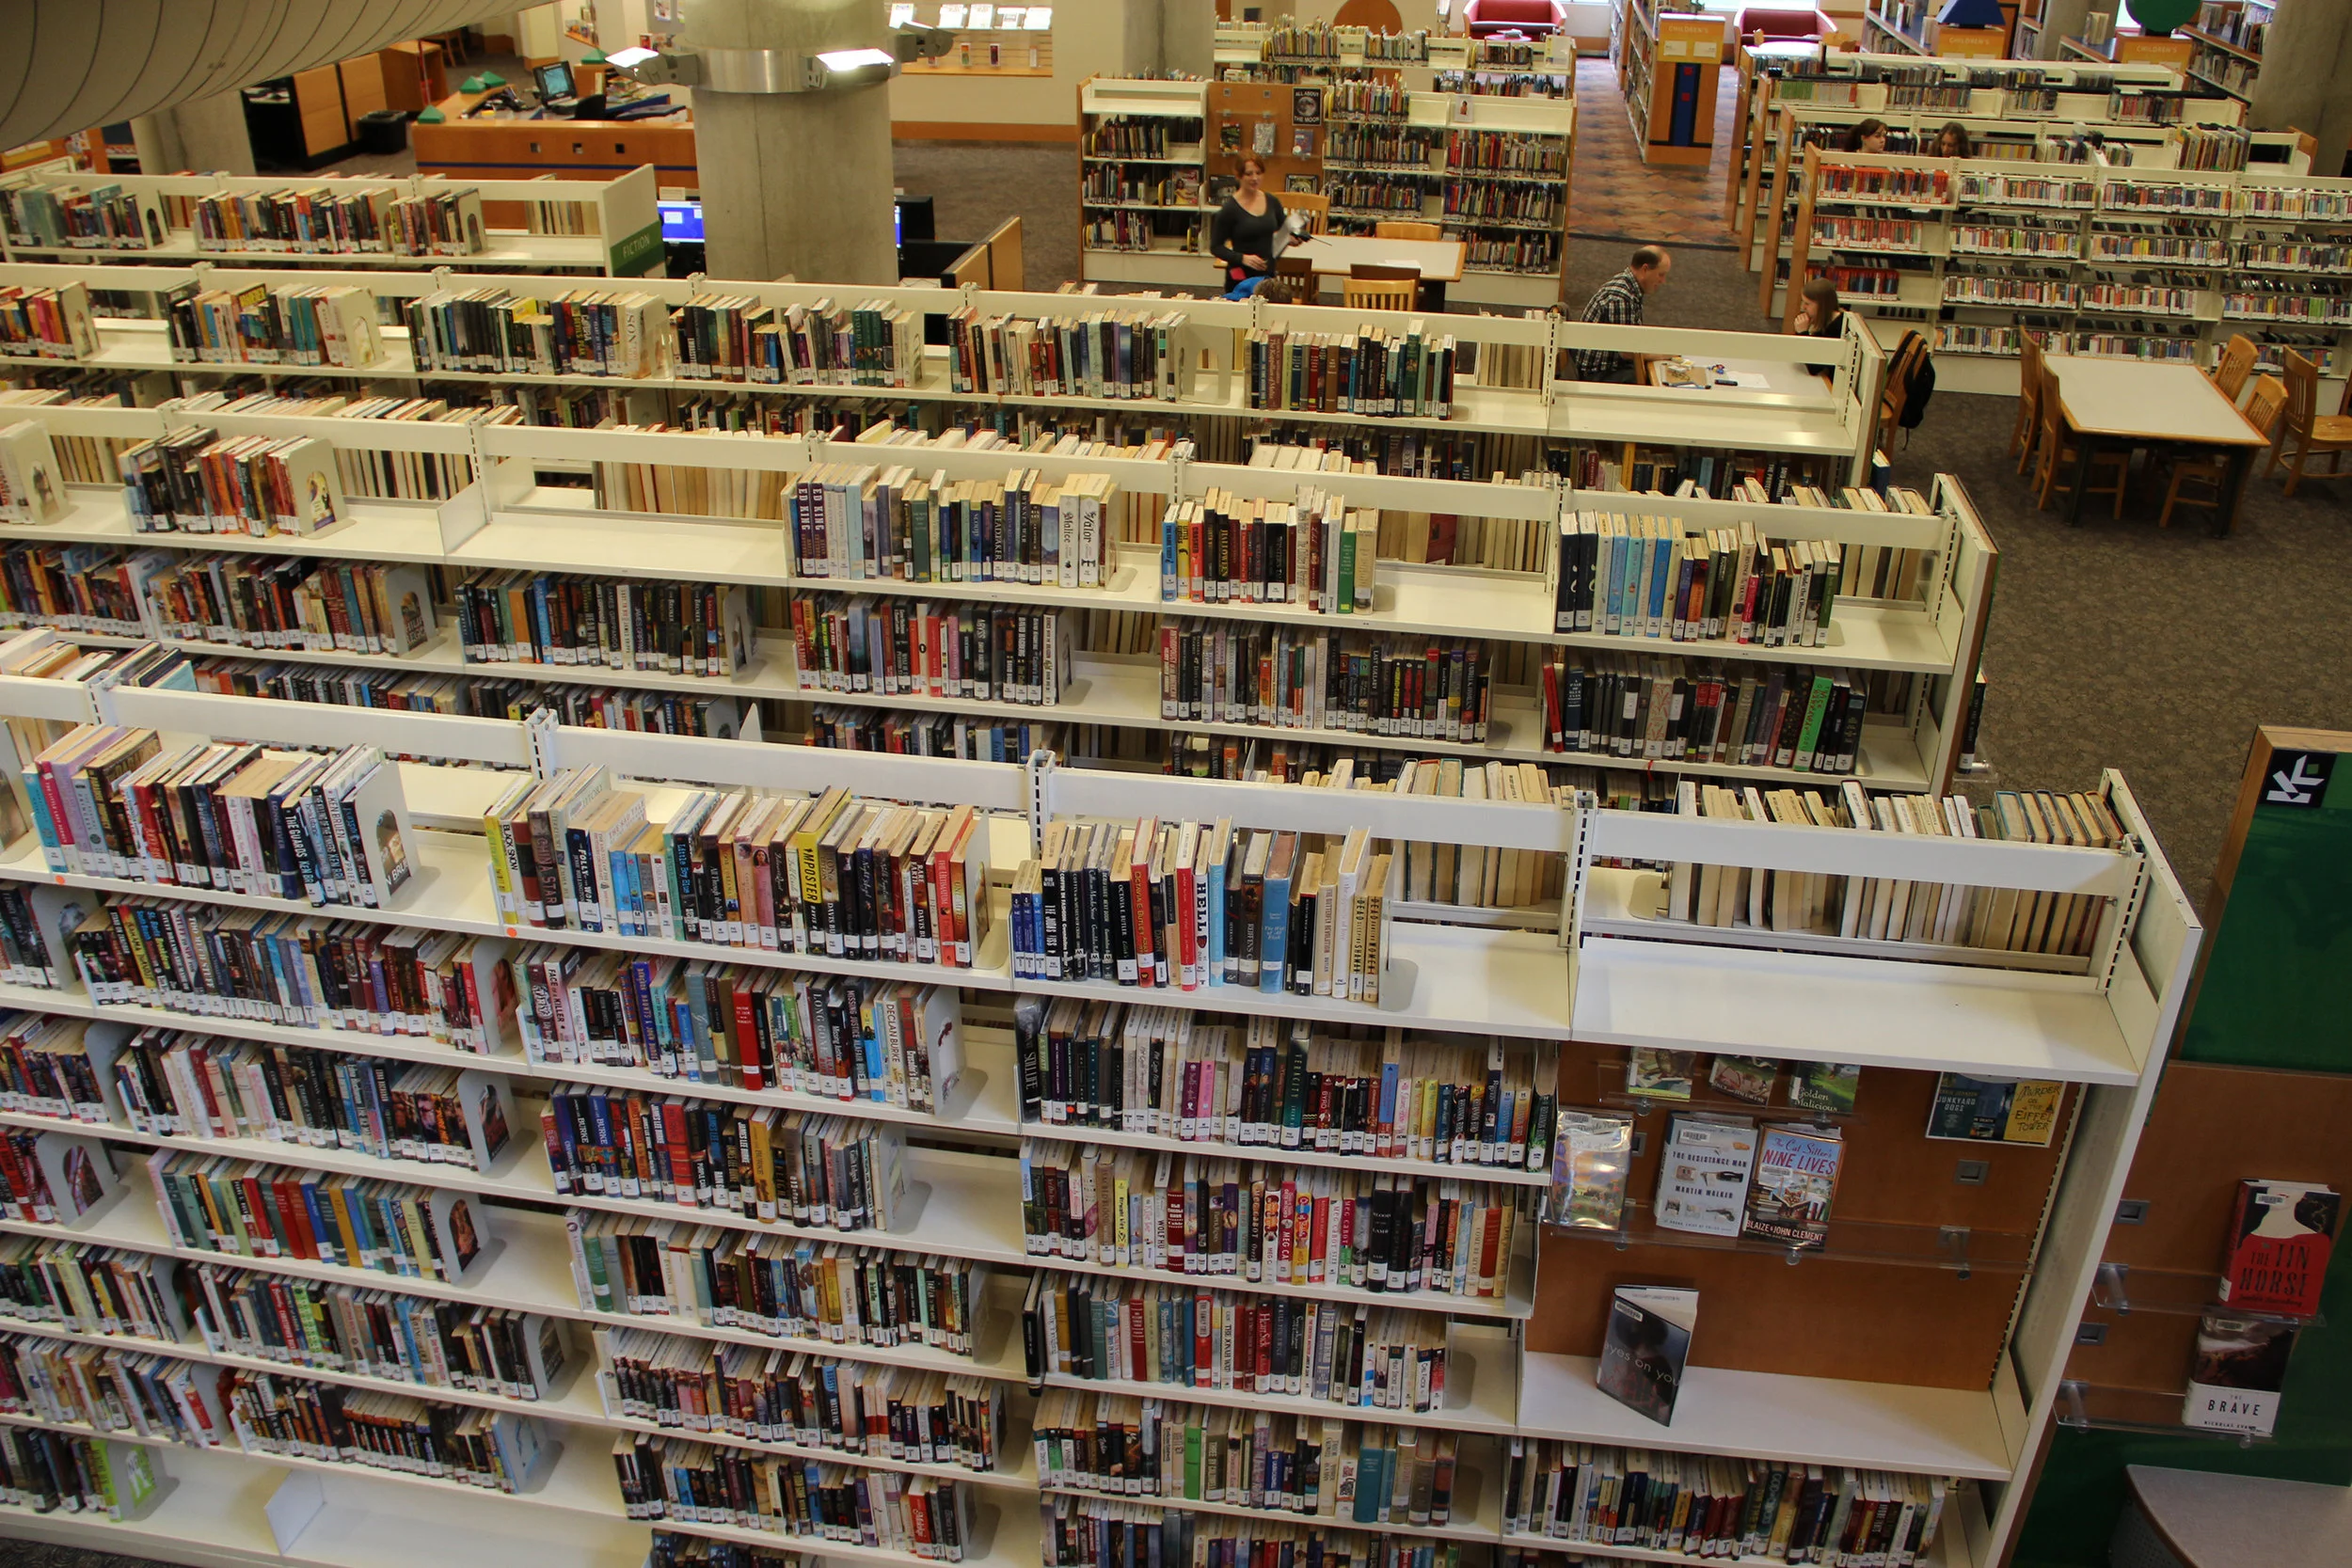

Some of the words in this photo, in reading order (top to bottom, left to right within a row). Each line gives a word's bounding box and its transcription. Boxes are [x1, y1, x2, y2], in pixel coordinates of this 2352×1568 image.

[622, 235, 650, 258] FICTION
[799, 488, 807, 500] ED
[813, 488, 822, 500] ED
[800, 506, 810, 530] KING
[814, 506, 824, 530] KING
[328, 797, 338, 812] KEN
[285, 816, 294, 829] THE
[332, 812, 346, 839] BRUEN
[289, 829, 308, 858] GUARDS
[502, 824, 514, 847] BLACK
[506, 847, 518, 870] SNOW
[579, 848, 589, 875] FOLLY
[676, 844, 686, 866] Little
[803, 847, 818, 902] IMPOSTER
[543, 875, 558, 904] STAR
[826, 903, 834, 921] DAVIS
[1197, 882, 1207, 931] HELL
[1356, 899, 1365, 921] DEAD
[1370, 897, 1379, 920] DEAD
[917, 910, 926, 927] DAVIS
[1154, 930, 1163, 952] DAWN
[548, 968, 559, 987] FACE
[553, 998, 565, 1022] KILLER
[813, 993, 825, 1022] LONG
[886, 1004, 898, 1035] DECLAN
[818, 1025, 827, 1053] GONE
[890, 1037, 900, 1063] BURKE
[1798, 1085, 1829, 1101] Golden
[1936, 1096, 1976, 1105] JUNKYARD
[2016, 1084, 2061, 1101] MURDER
[1794, 1098, 1837, 1113] Malicious
[2015, 1110, 2054, 1122] EIFFEL
[578, 1117, 589, 1144] BURKE
[596, 1118, 608, 1145] BURKE
[2017, 1121, 2049, 1133] TOWER
[1673, 1150, 1685, 1160] THE
[1687, 1152, 1729, 1166] RESISTANCE
[1732, 1159, 1747, 1167] MAN
[1785, 1138, 1803, 1152] Cat
[1803, 1142, 1833, 1158] Sitter's
[1762, 1149, 1796, 1168] NINE
[1797, 1155, 1836, 1175] LIVES
[1675, 1185, 1703, 1196] MARTIN
[1706, 1190, 1734, 1199] WALKER
[1282, 1231, 1291, 1247] MEG
[1746, 1220, 1771, 1231] BLAIZE
[1773, 1225, 1791, 1236] JOHN
[1791, 1229, 1823, 1242] CLEMENT
[2250, 1251, 2269, 1267] THE
[2275, 1243, 2311, 1268] TIN
[2239, 1268, 2310, 1297] HORSE
[1604, 1342, 1630, 1362] eyes
[1634, 1358, 1651, 1372] on
[1656, 1369, 1679, 1386] you
[2208, 1400, 2261, 1416] BRAVE
[2203, 1419, 2234, 1428] NICHOLAS
